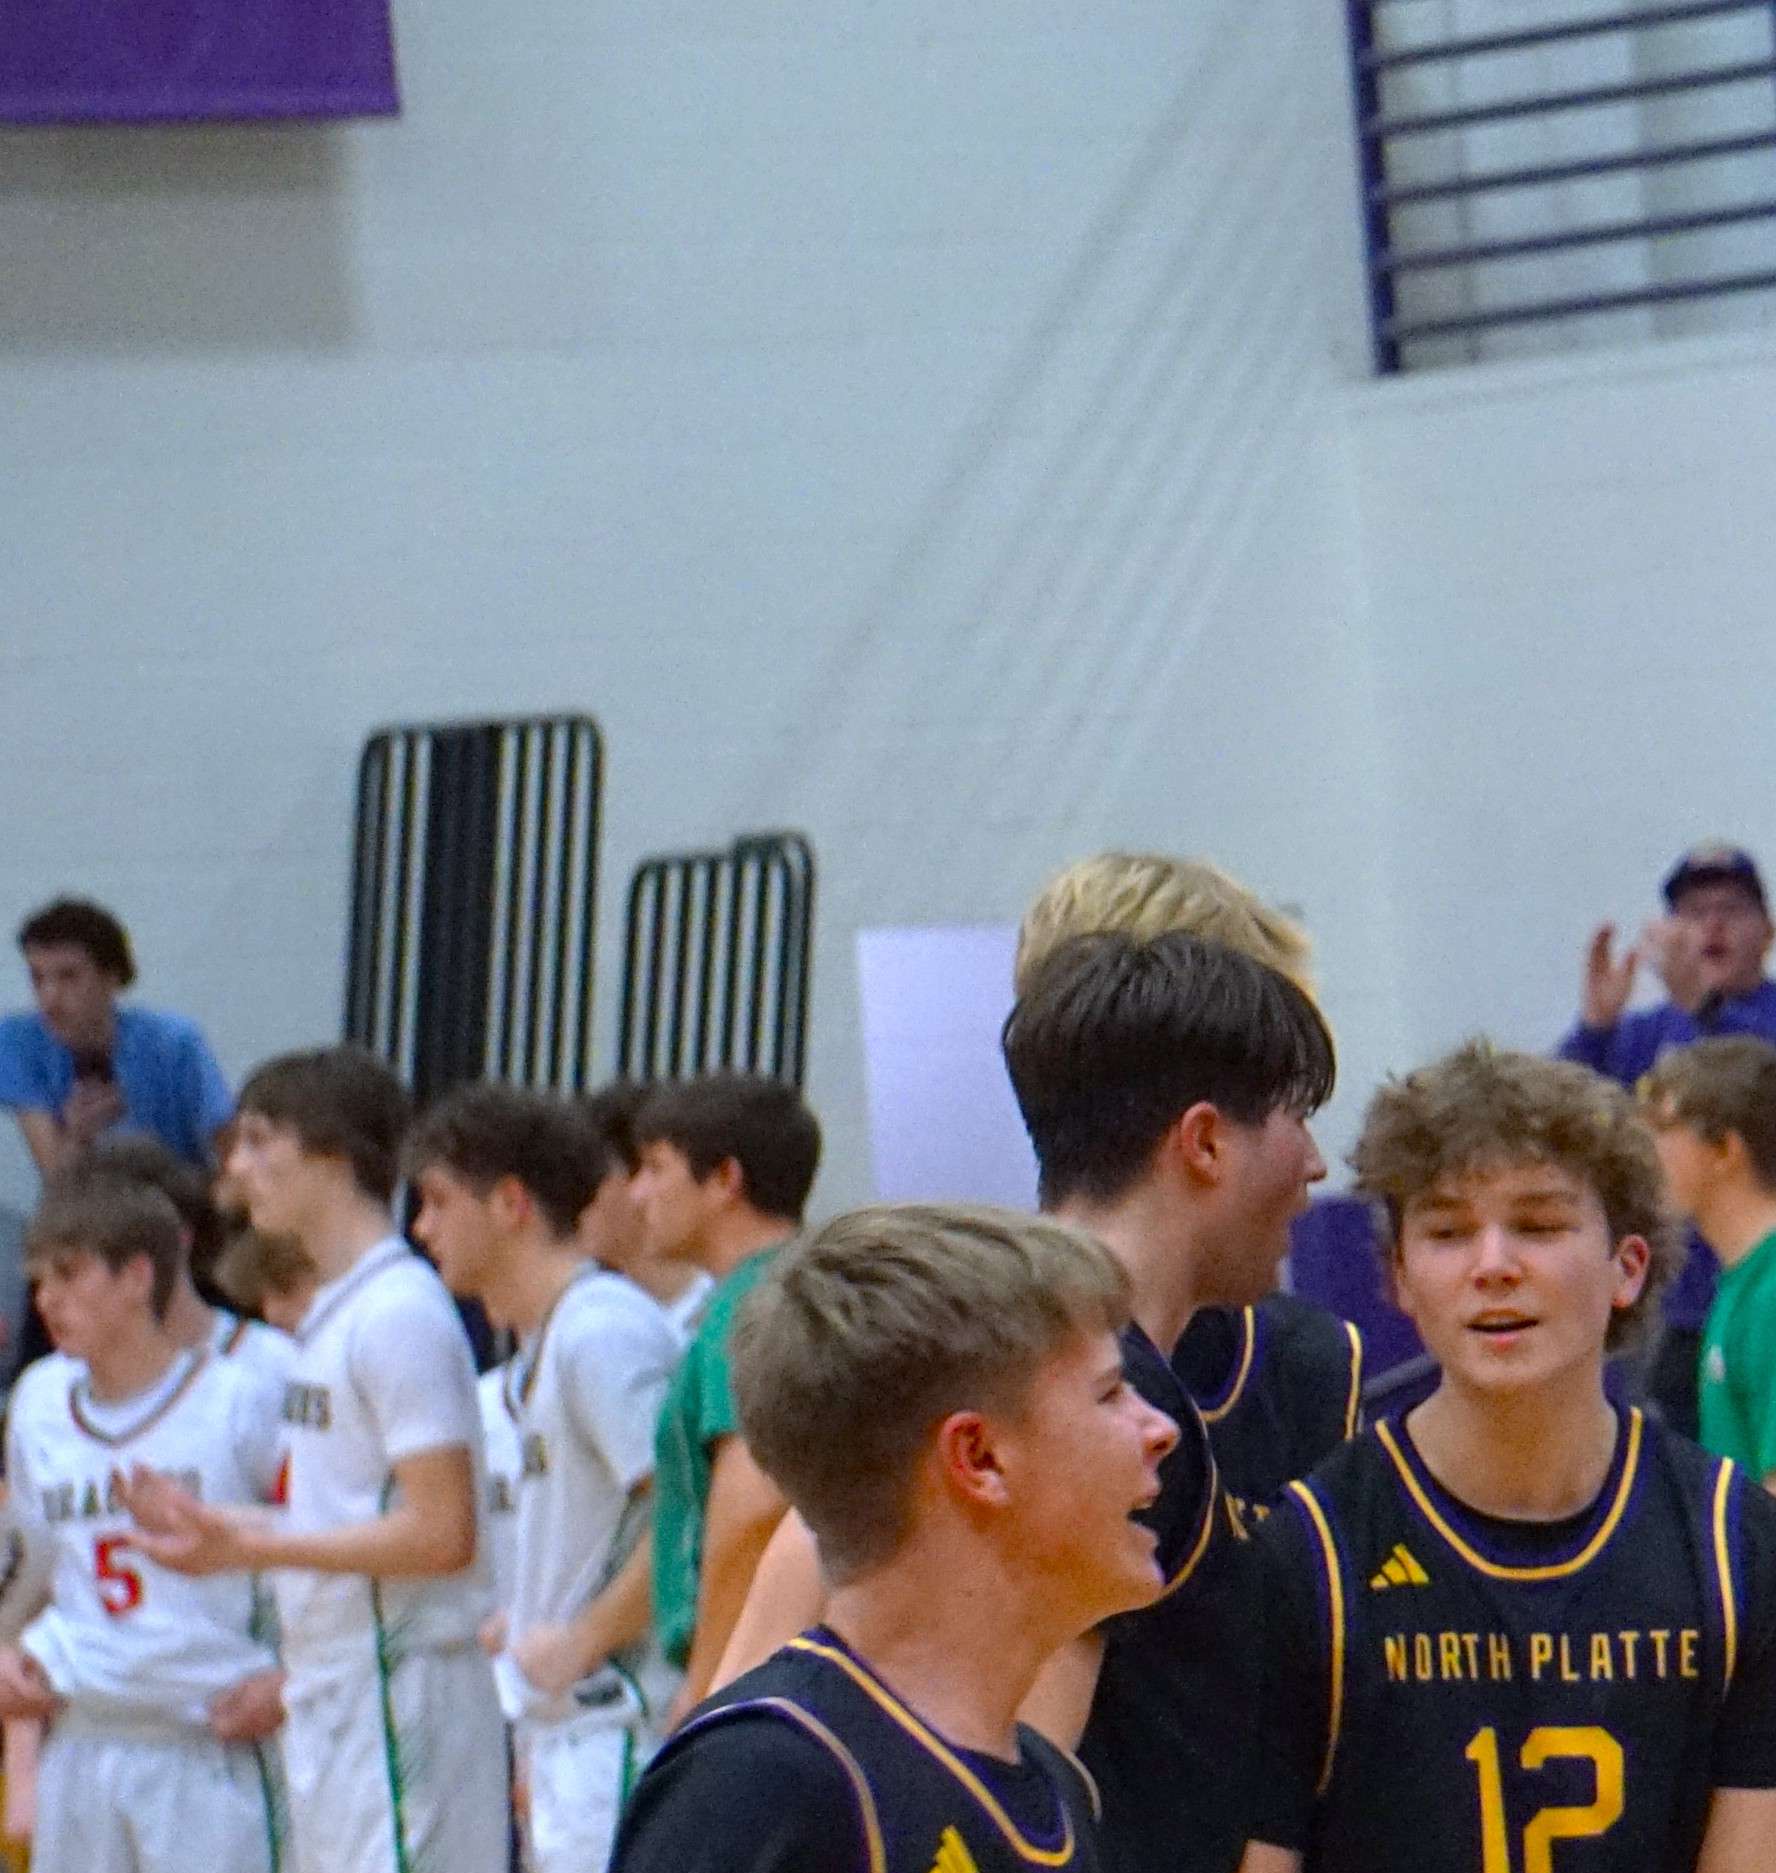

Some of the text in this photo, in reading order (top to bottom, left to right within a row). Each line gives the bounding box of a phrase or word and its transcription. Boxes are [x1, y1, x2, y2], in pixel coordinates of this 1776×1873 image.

[96, 1533, 145, 1620] 5
[1384, 1629, 1700, 1682] NORTH PLATTE
